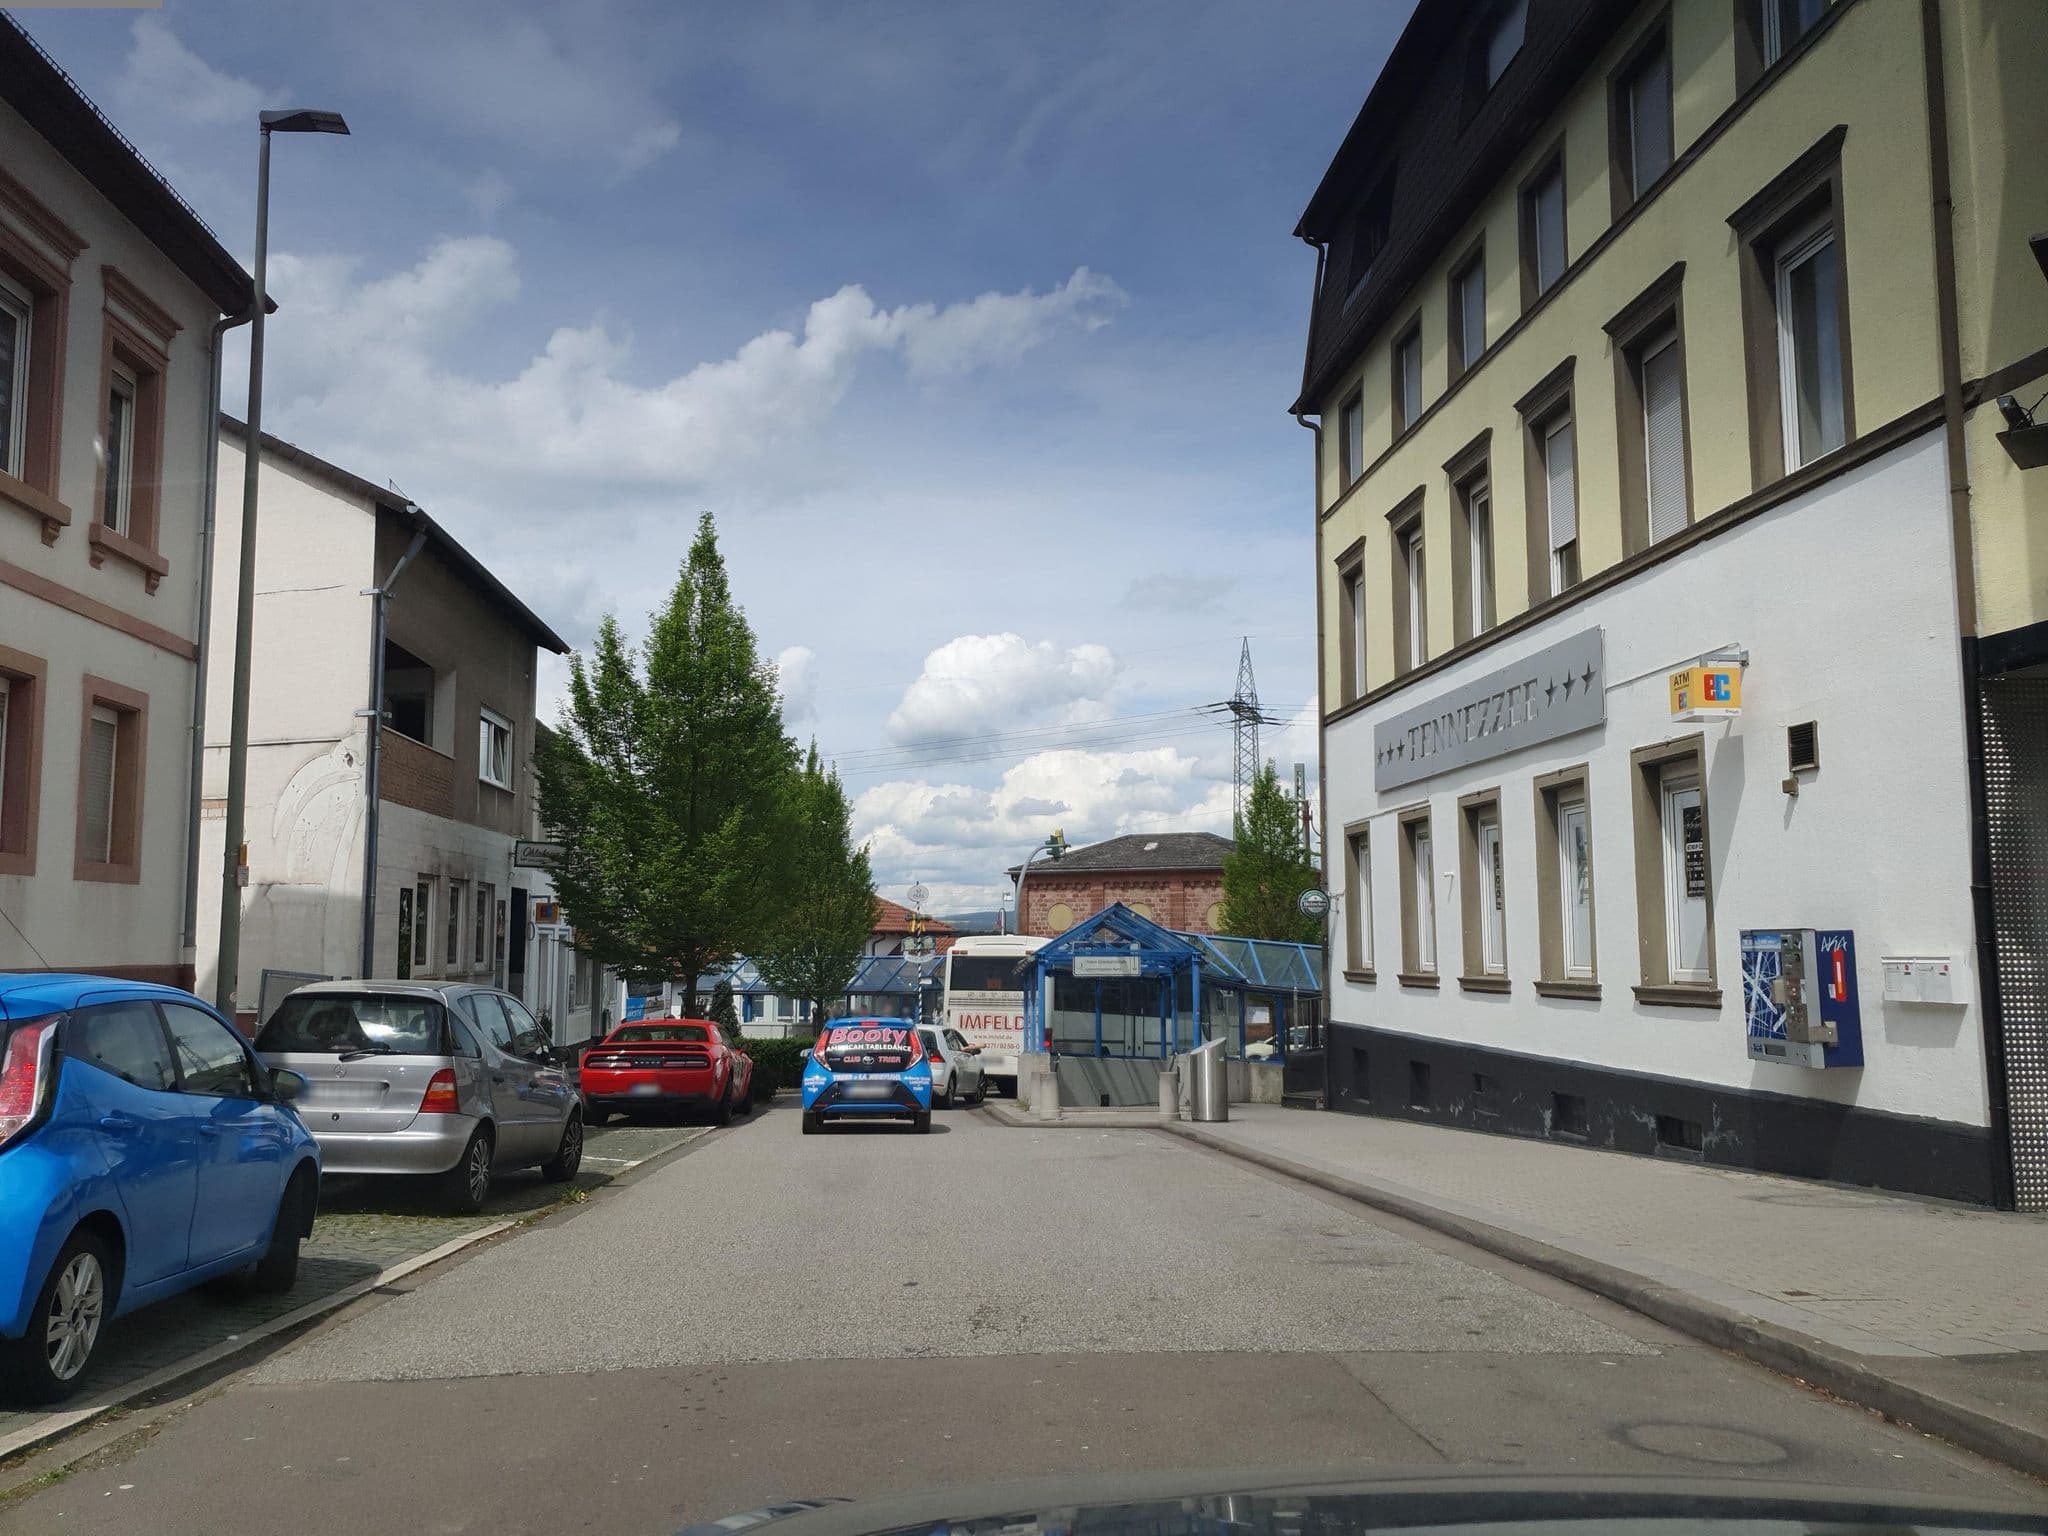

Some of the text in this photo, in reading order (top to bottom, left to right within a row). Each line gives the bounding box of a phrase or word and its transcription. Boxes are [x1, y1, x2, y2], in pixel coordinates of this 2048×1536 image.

[1674, 671, 1690, 687] ATM
[1407, 678, 1538, 761] TENNEZZEE
[960, 1014, 1024, 1031] IMFELD
[828, 1027, 908, 1045] Booty
[826, 1043, 912, 1052] AMERICAN TABLEDANCE
